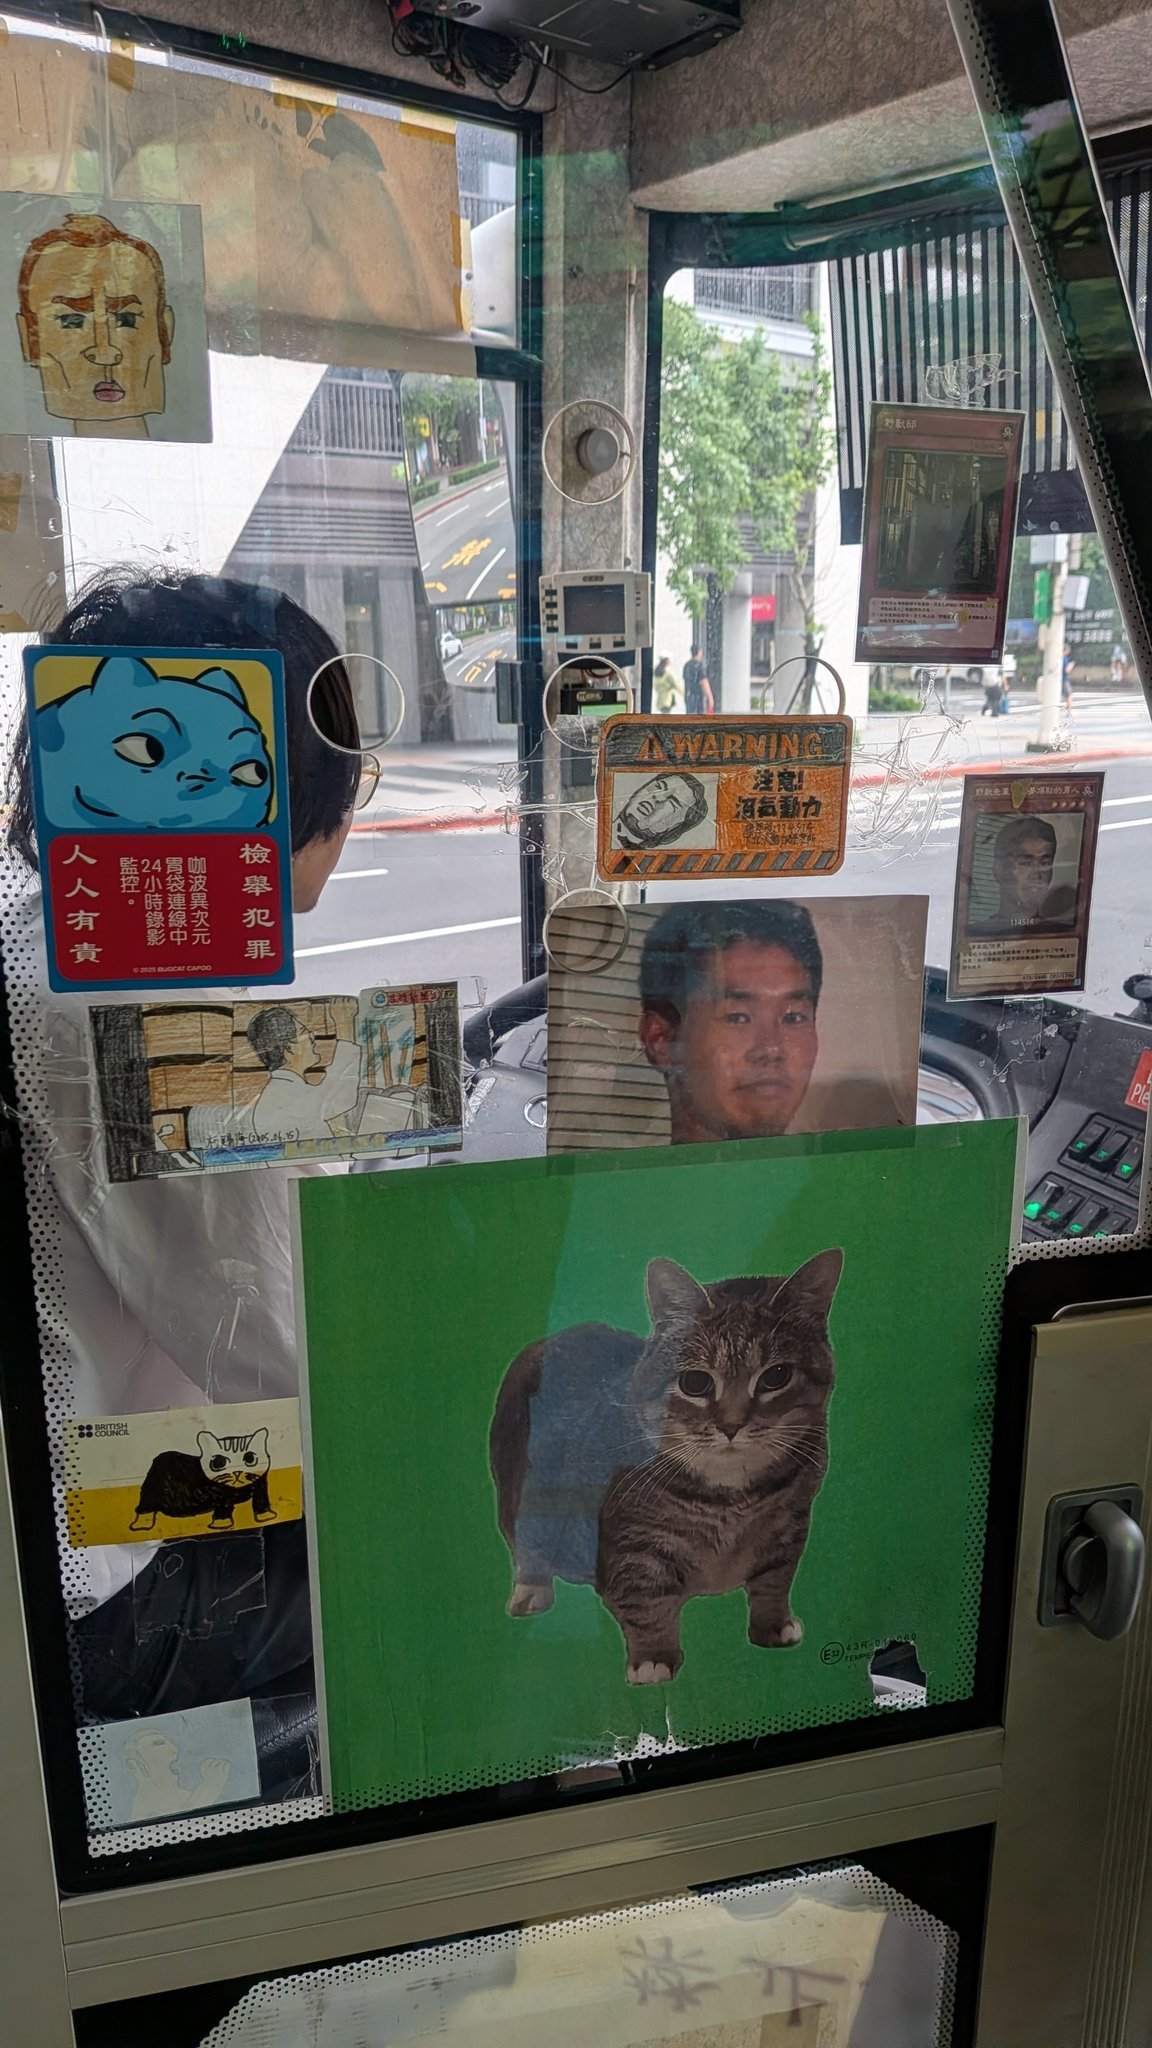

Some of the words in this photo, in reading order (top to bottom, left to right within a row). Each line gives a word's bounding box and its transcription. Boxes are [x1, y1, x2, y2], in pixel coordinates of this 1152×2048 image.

[671, 733, 824, 760] WARNING
[62, 844, 104, 964] 人人有責
[141, 857, 166, 946] 24小時錄影
[165, 857, 188, 946] 胃袋連線中
[188, 857, 211, 946] 咖波異次元
[239, 843, 276, 960] 檢舉犯罪
